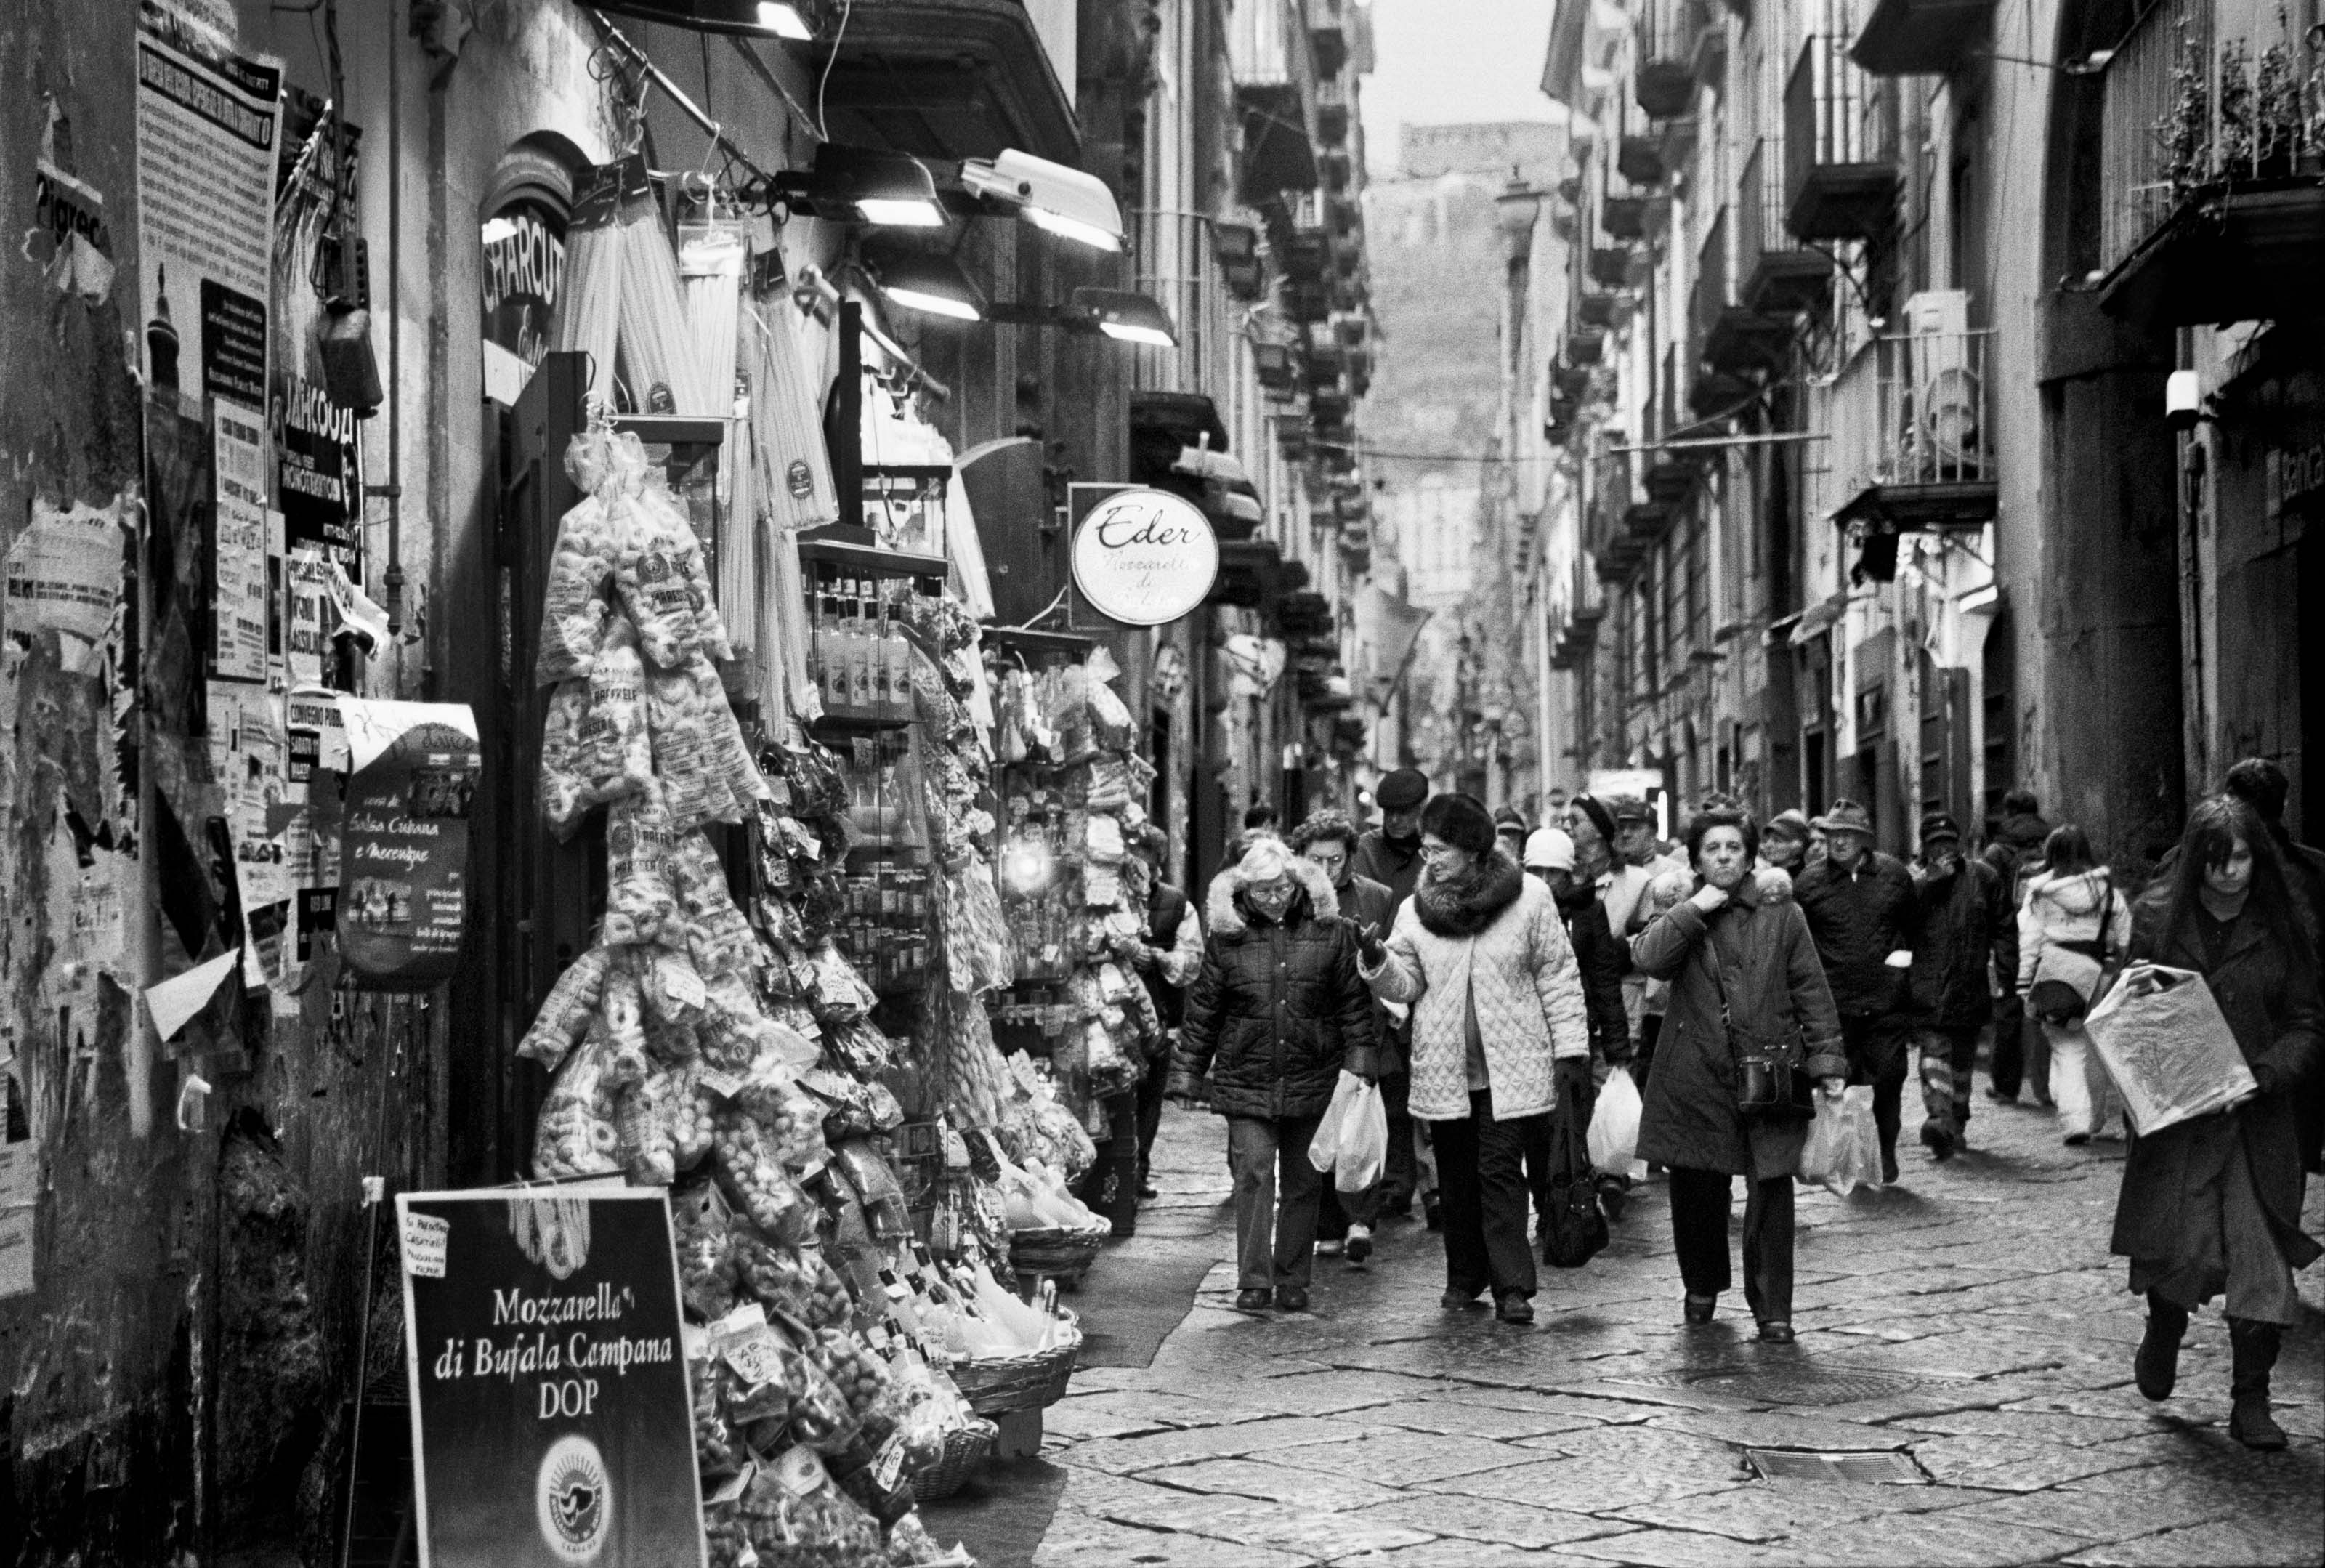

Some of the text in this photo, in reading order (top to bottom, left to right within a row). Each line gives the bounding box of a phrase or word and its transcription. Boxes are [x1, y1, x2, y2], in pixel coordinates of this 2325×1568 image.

[1096, 504, 1201, 549] Eder
[349, 812, 440, 836] Salsa Cubana
[355, 842, 429, 871] e Merengue
[493, 1281, 622, 1326] Mozzarella
[434, 1331, 673, 1383] di Bufala Campana
[538, 1378, 599, 1419] DOP
